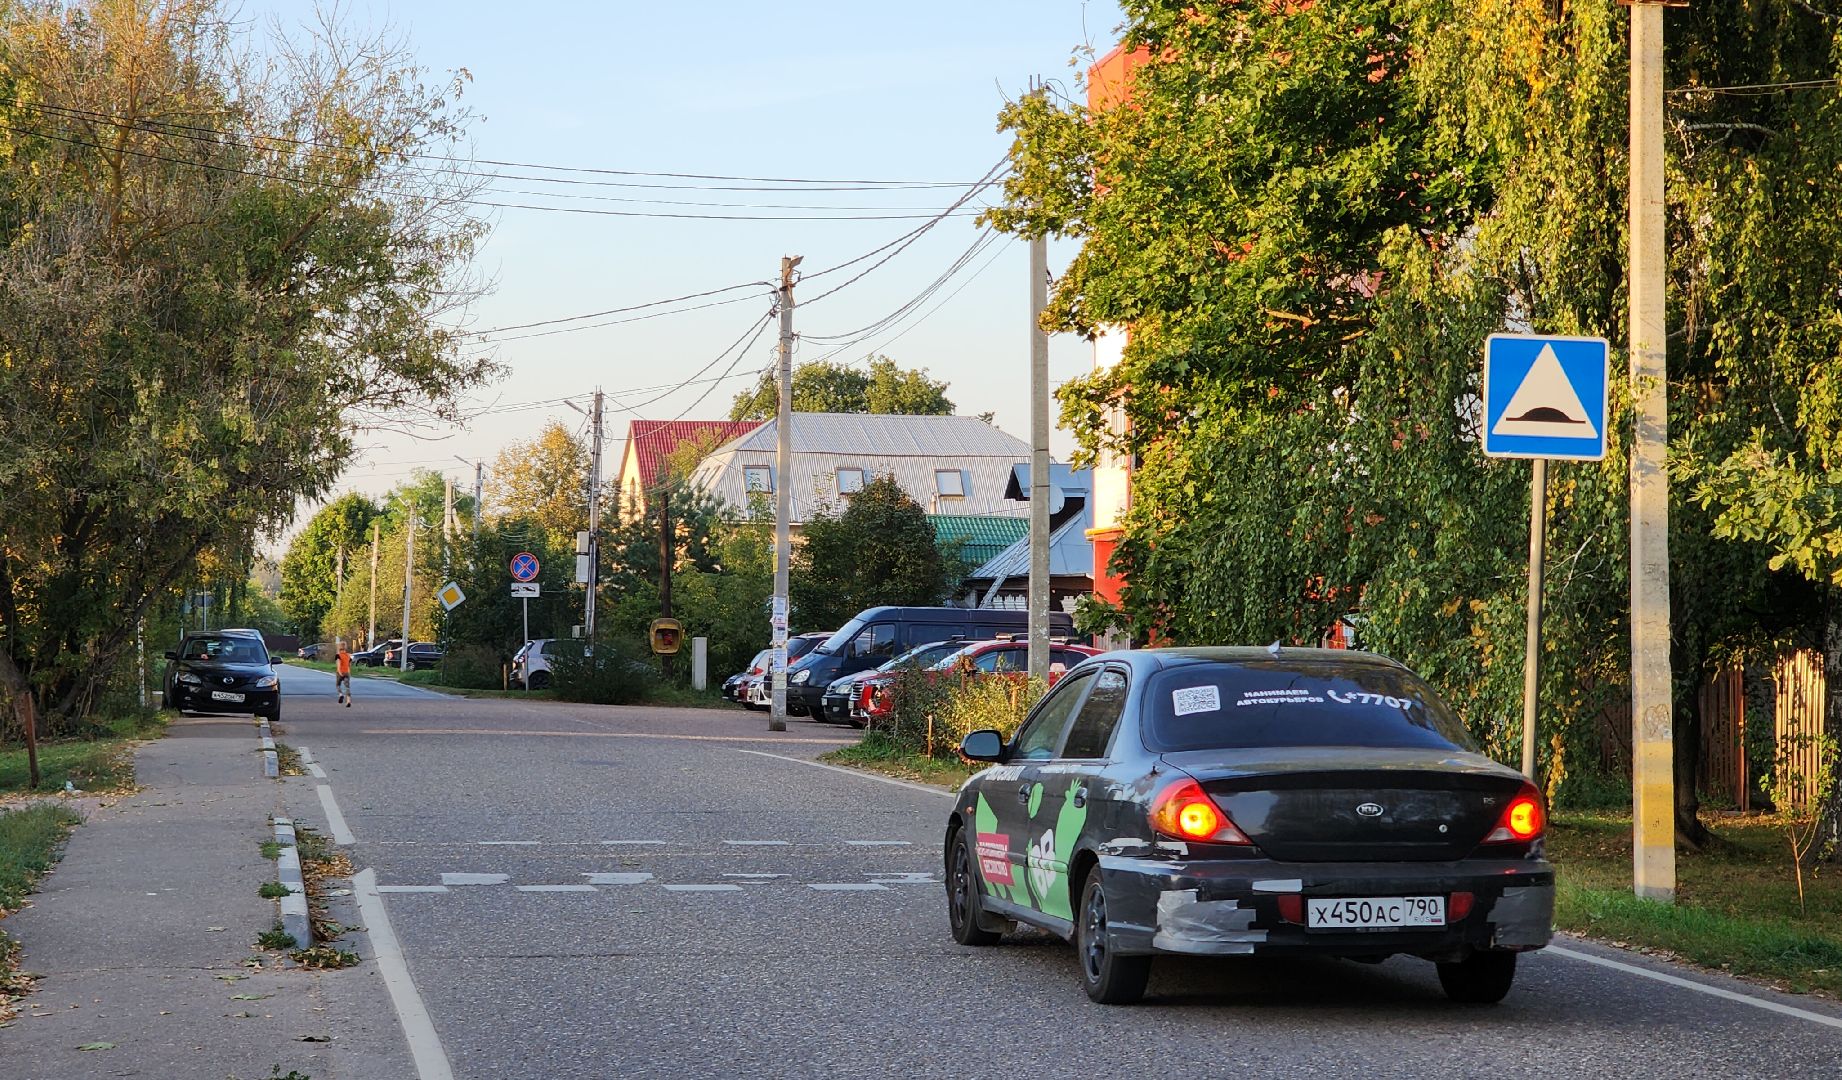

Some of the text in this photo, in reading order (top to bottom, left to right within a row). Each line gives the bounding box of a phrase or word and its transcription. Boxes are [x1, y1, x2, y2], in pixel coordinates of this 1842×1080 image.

[1243, 689, 1309, 698] НАНИМАЕМ
[1236, 696, 1325, 706] АВТОКУРЬЕРОВ
[1405, 898, 1439, 917] 790
